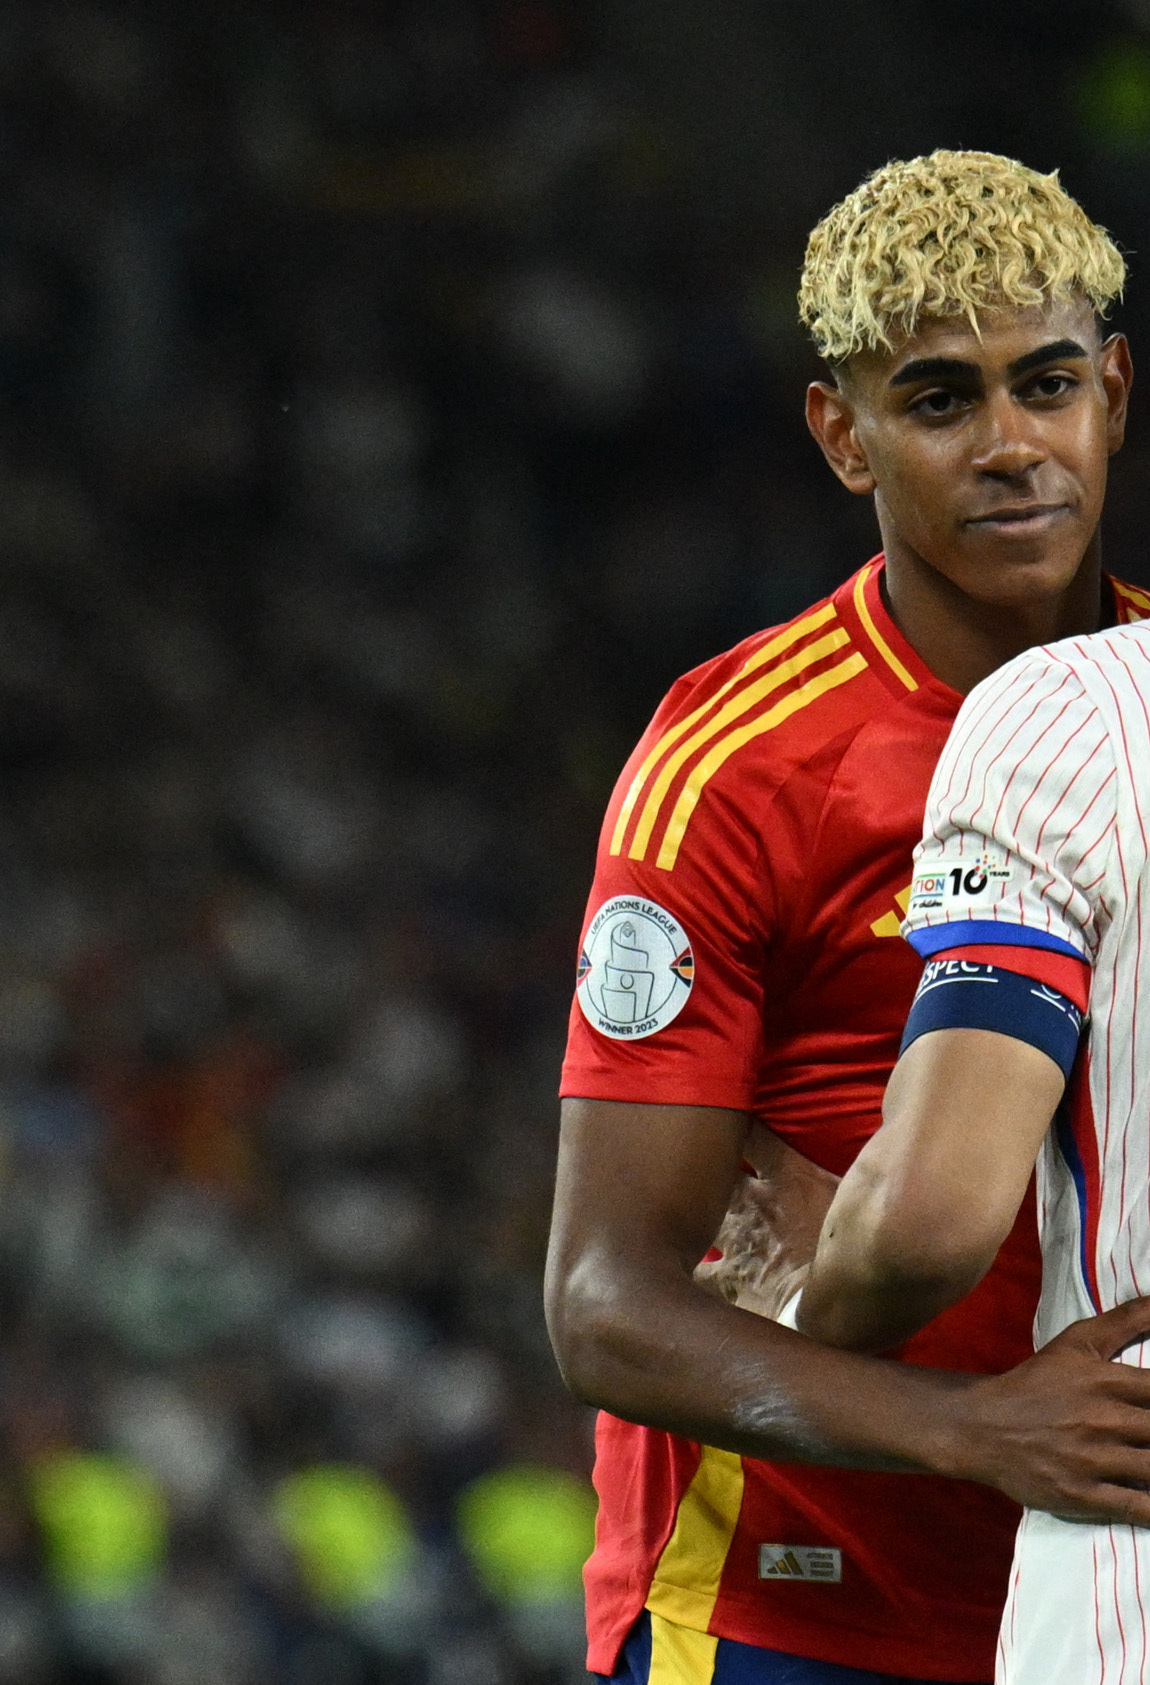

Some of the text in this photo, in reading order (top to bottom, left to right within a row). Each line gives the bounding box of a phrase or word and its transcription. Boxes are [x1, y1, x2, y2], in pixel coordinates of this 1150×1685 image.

[949, 866, 988, 896] 10
[591, 900, 677, 935] UEFA NATIONS LEAGUE
[598, 1017, 659, 1035] WINNER 2023
